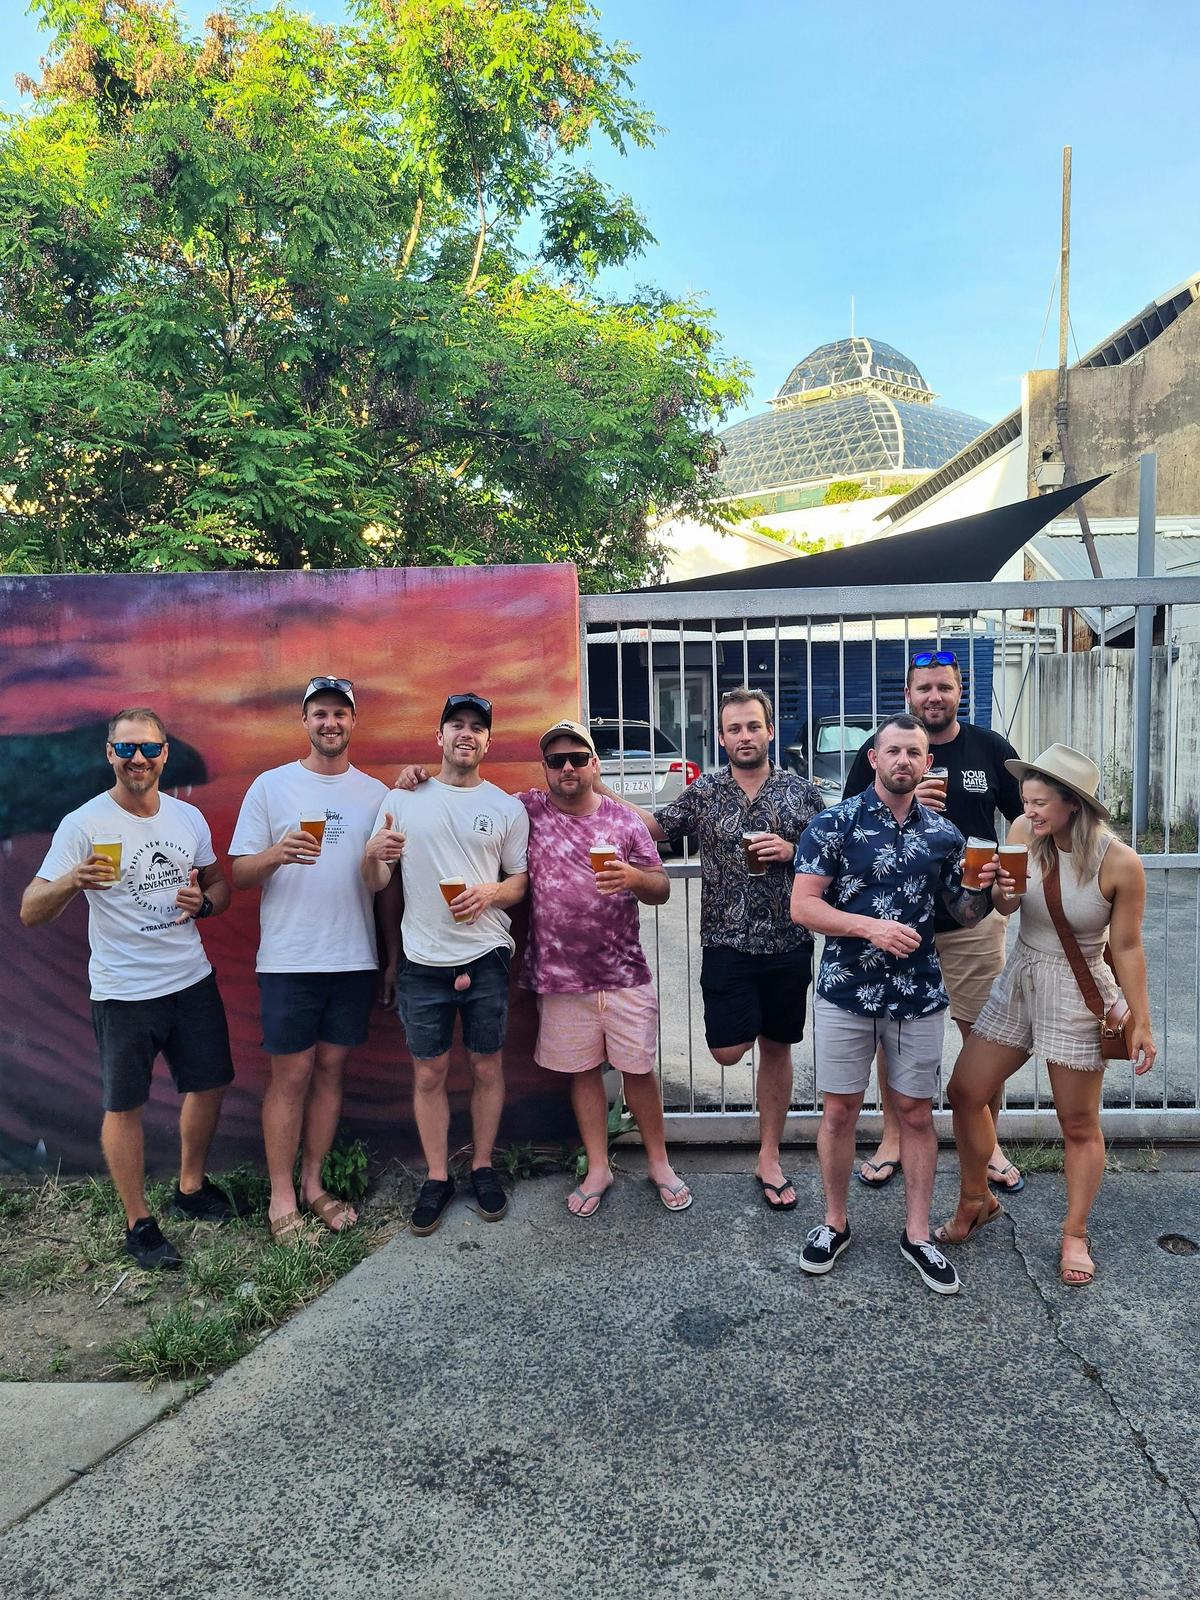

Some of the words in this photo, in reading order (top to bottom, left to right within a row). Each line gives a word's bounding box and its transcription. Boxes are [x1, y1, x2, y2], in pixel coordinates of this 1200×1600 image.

[961, 770, 986, 779] YOUR
[963, 777, 988, 787] MATES
[129, 848, 144, 870] PAPUA
[145, 840, 160, 849] NEW
[165, 840, 190, 858] GUINEA
[145, 873, 156, 881] NO
[157, 868, 180, 879] LIMIT
[138, 876, 184, 892] ADVENTURE
[127, 880, 157, 912] AUSTRALIA
